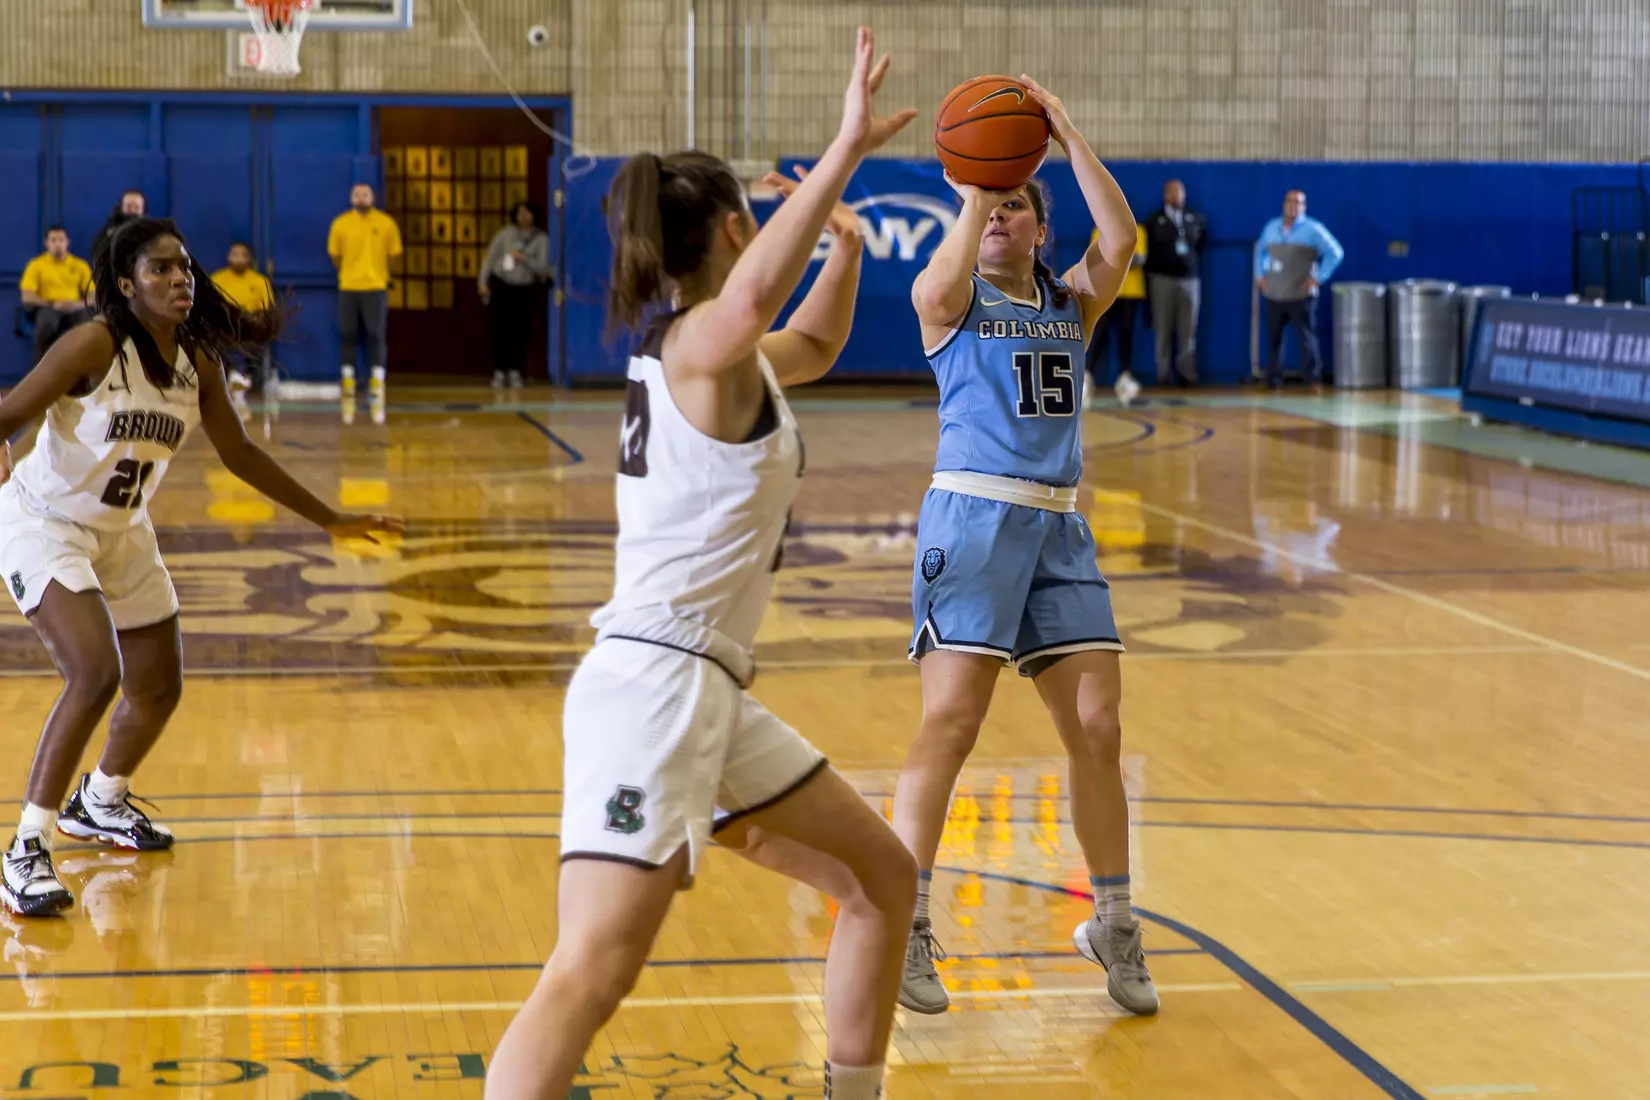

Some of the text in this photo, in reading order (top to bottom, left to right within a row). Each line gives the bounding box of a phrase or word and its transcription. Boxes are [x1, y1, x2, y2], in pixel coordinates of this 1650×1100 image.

[809, 216, 937, 261] NY
[977, 319, 1083, 342] COLUMBIA
[1012, 351, 1077, 419] 15
